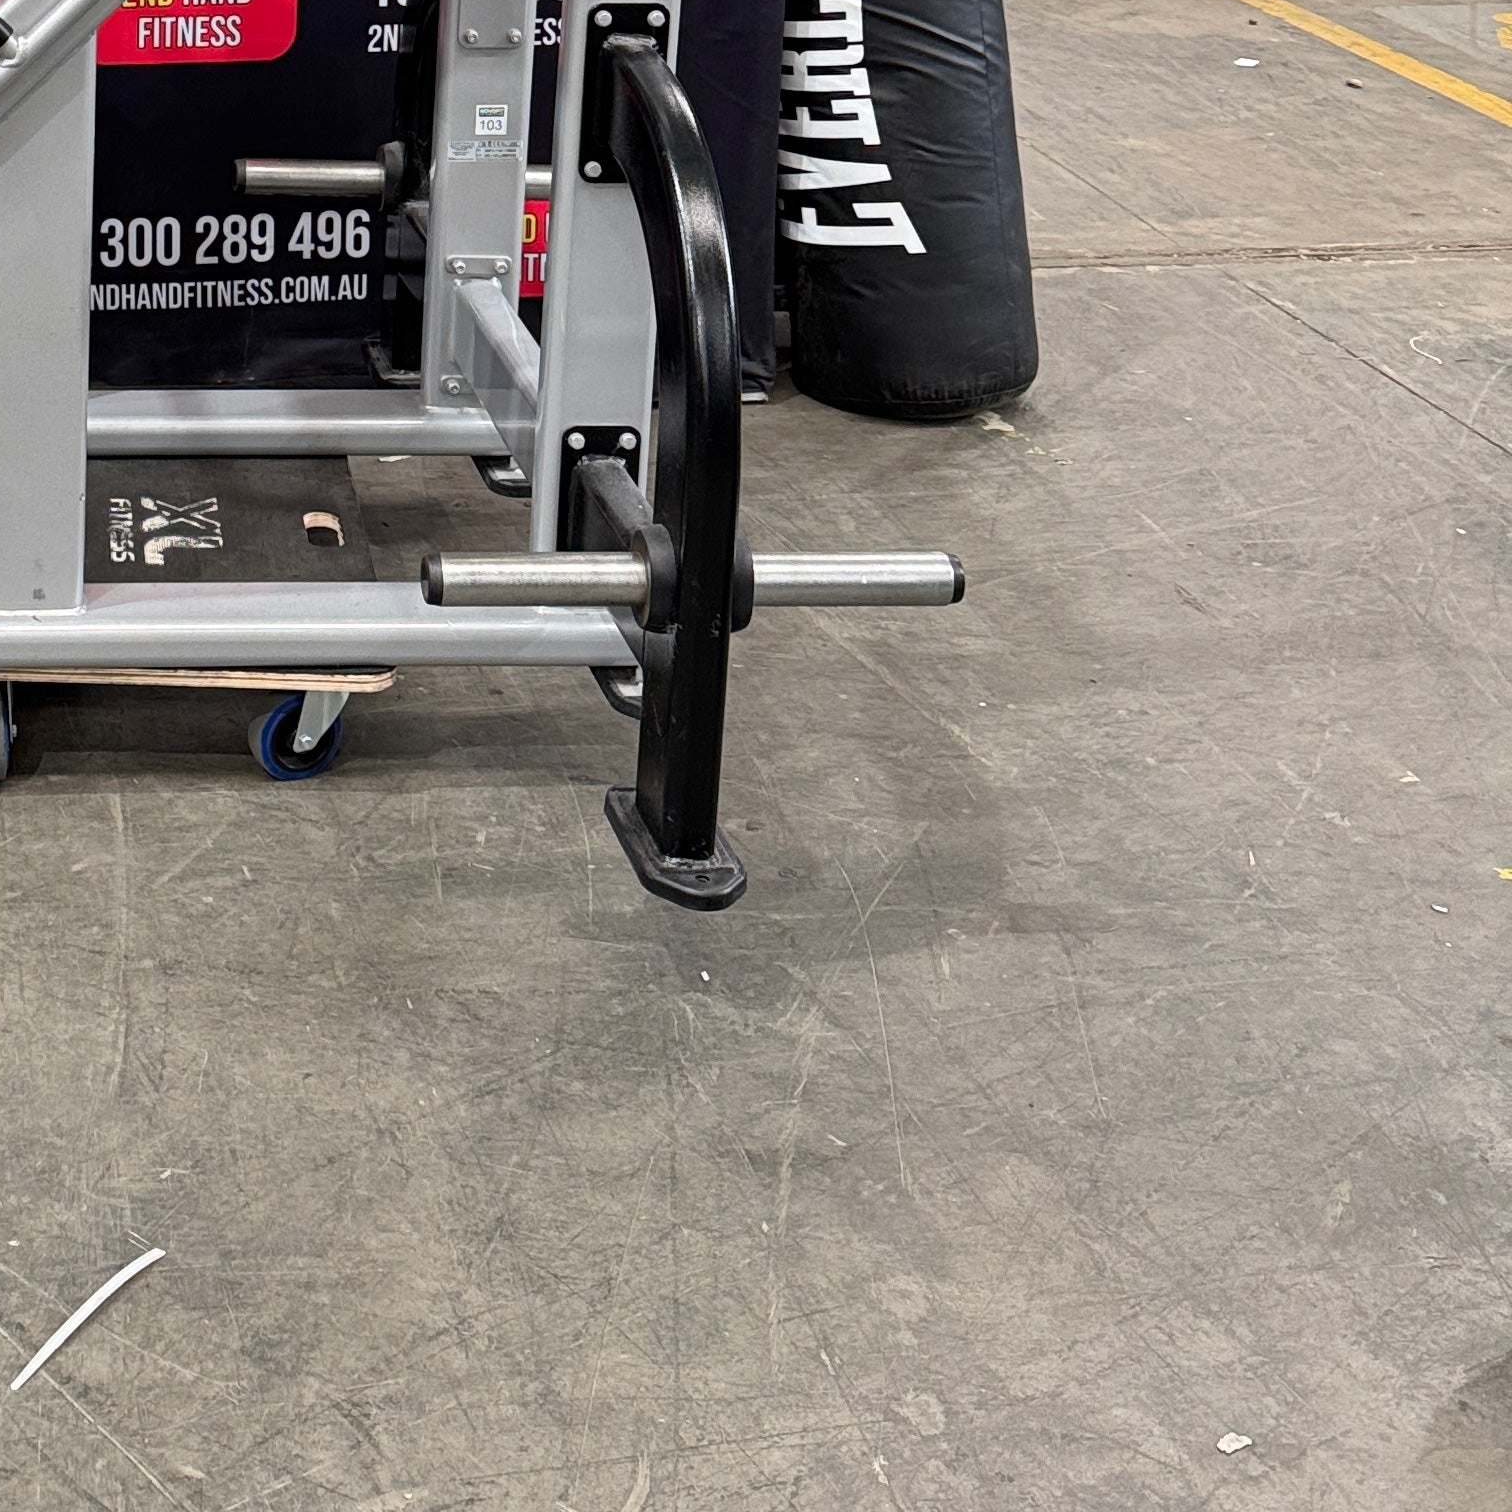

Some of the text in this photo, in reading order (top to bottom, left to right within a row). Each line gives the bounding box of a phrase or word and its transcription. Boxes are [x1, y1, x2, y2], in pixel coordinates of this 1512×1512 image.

[138, 15, 241, 49] FITNESS
[480, 120, 503, 131] 103
[100, 209, 371, 268] 300 289 496
[90, 274, 368, 311] NDHANDFITNESS.COM.AU
